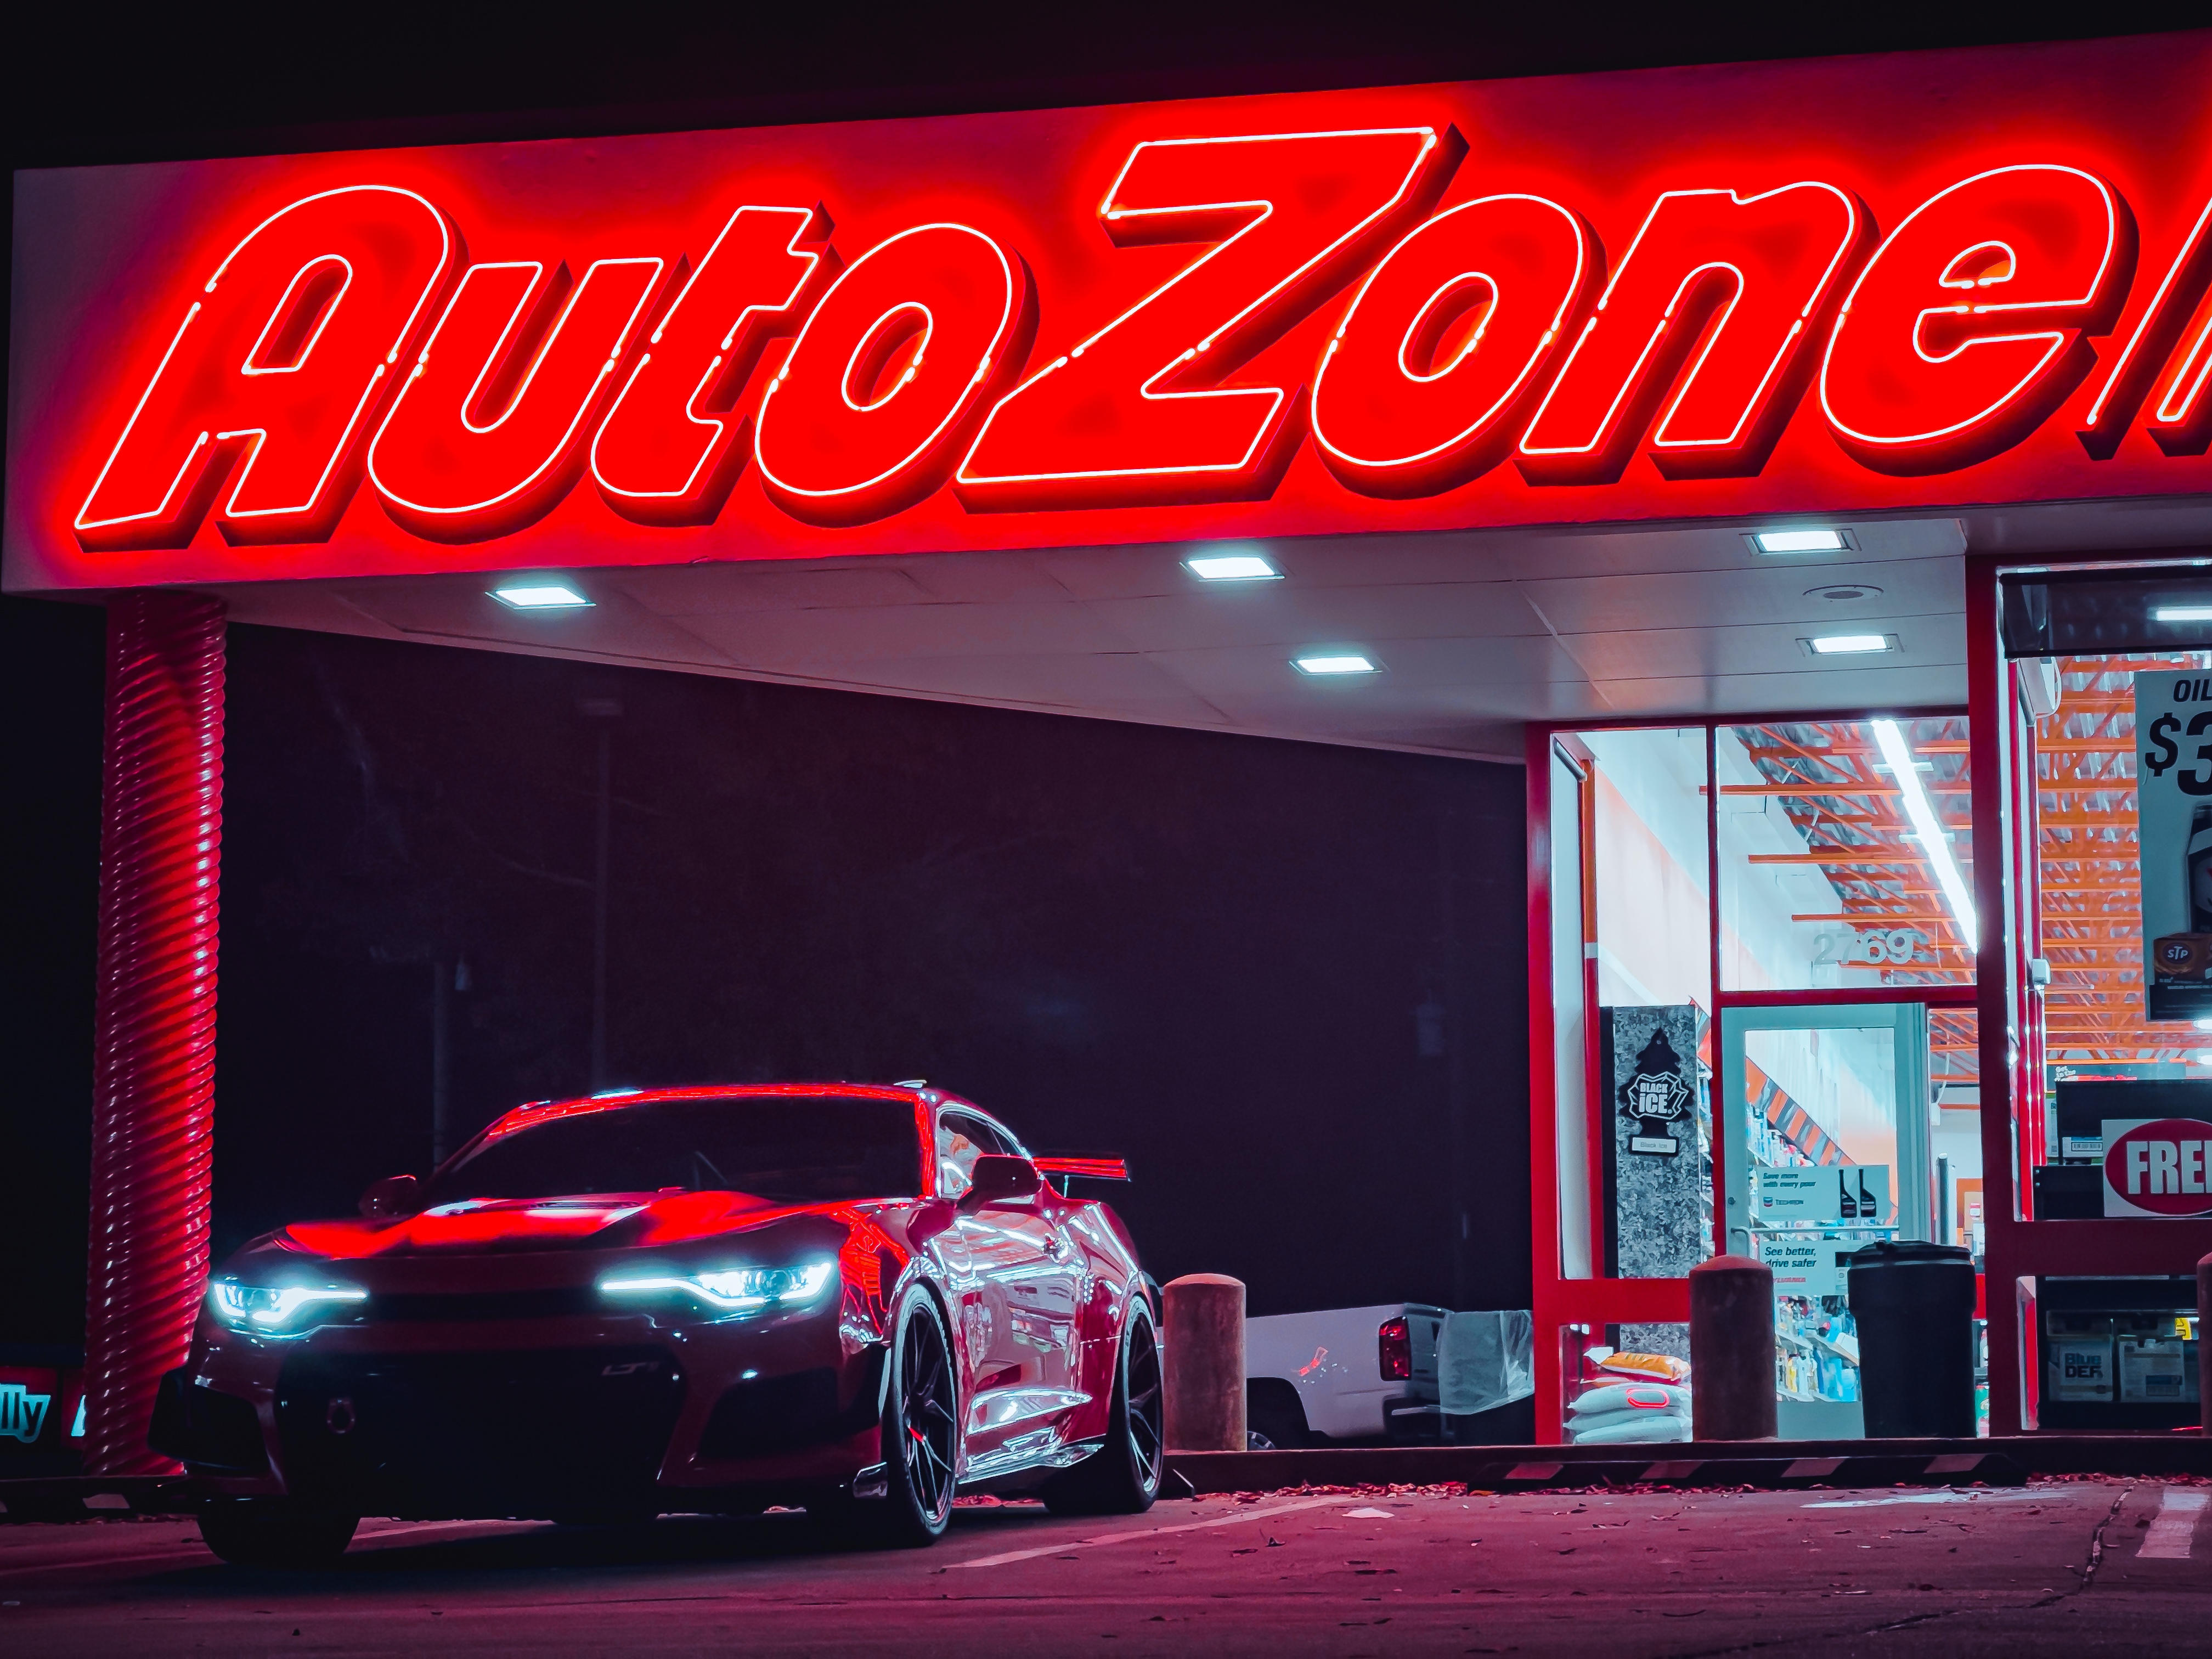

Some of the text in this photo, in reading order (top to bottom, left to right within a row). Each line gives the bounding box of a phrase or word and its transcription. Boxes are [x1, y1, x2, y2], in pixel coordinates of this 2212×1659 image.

[73, 122, 2134, 540] AutoZone
[1813, 928, 1914, 966] 2769
[2168, 946, 2189, 960] STP
[1640, 1082, 1668, 1094] BLACK
[1764, 1246, 1816, 1256] See better,
[1792, 1258, 1817, 1267] safer
[2064, 1352, 2102, 1365] Blue
[2064, 1365, 2103, 1378] DEF
